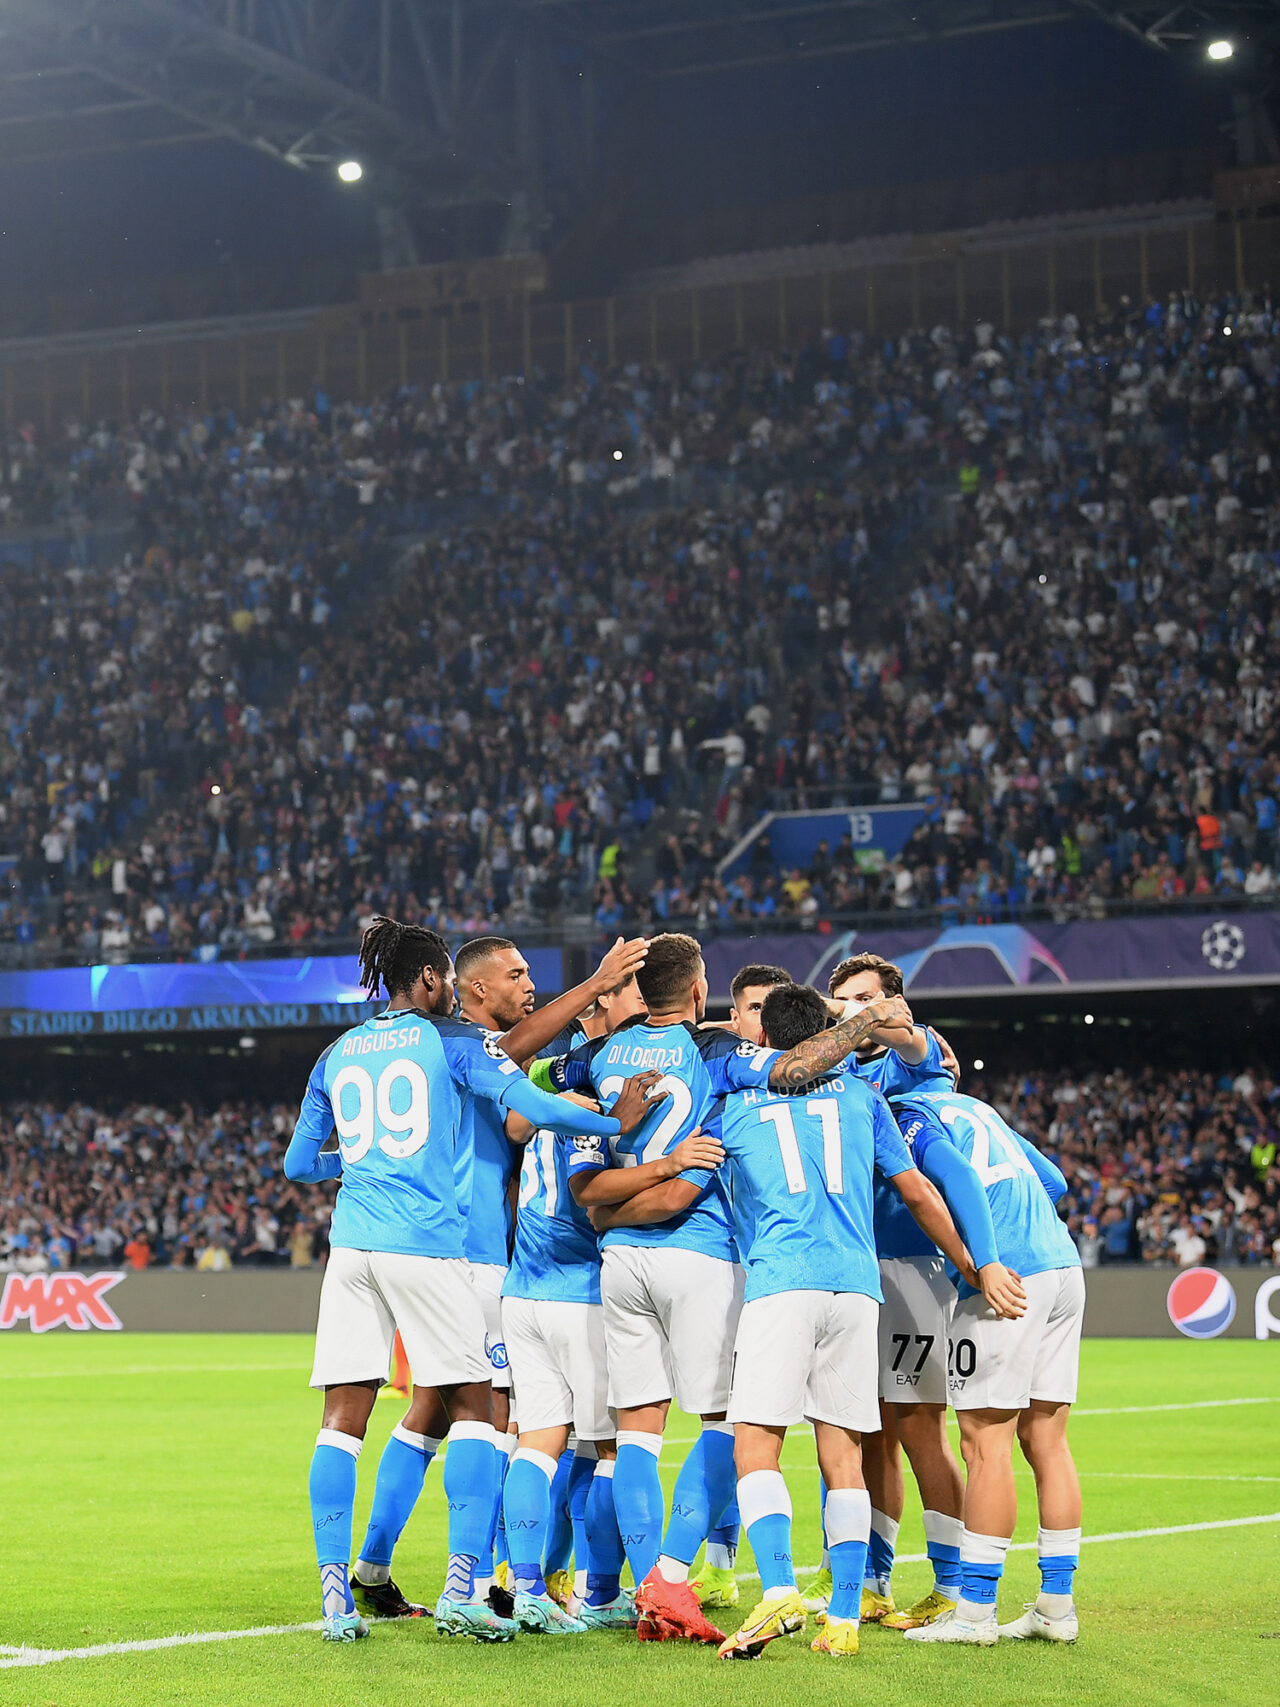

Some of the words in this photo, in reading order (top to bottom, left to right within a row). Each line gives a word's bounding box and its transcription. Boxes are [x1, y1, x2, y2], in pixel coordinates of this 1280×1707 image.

[847, 813, 873, 843] 13
[10, 1011, 93, 1036] STADIO
[102, 1008, 179, 1033] DIEGO
[187, 1004, 309, 1030] ARMANDO
[341, 1026, 421, 1057] ANGUISSA
[607, 1044, 620, 1065] DI
[622, 1045, 683, 1069] LORENZO
[331, 1058, 430, 1165] 99
[759, 1098, 844, 1195] 11
[891, 1332, 936, 1373] 77
[896, 1374, 921, 1386] EA7
[316, 1511, 345, 1530] EA7
[510, 1519, 539, 1531] EA7
[621, 1533, 647, 1546] EA7
[838, 1581, 860, 1591] EA7
